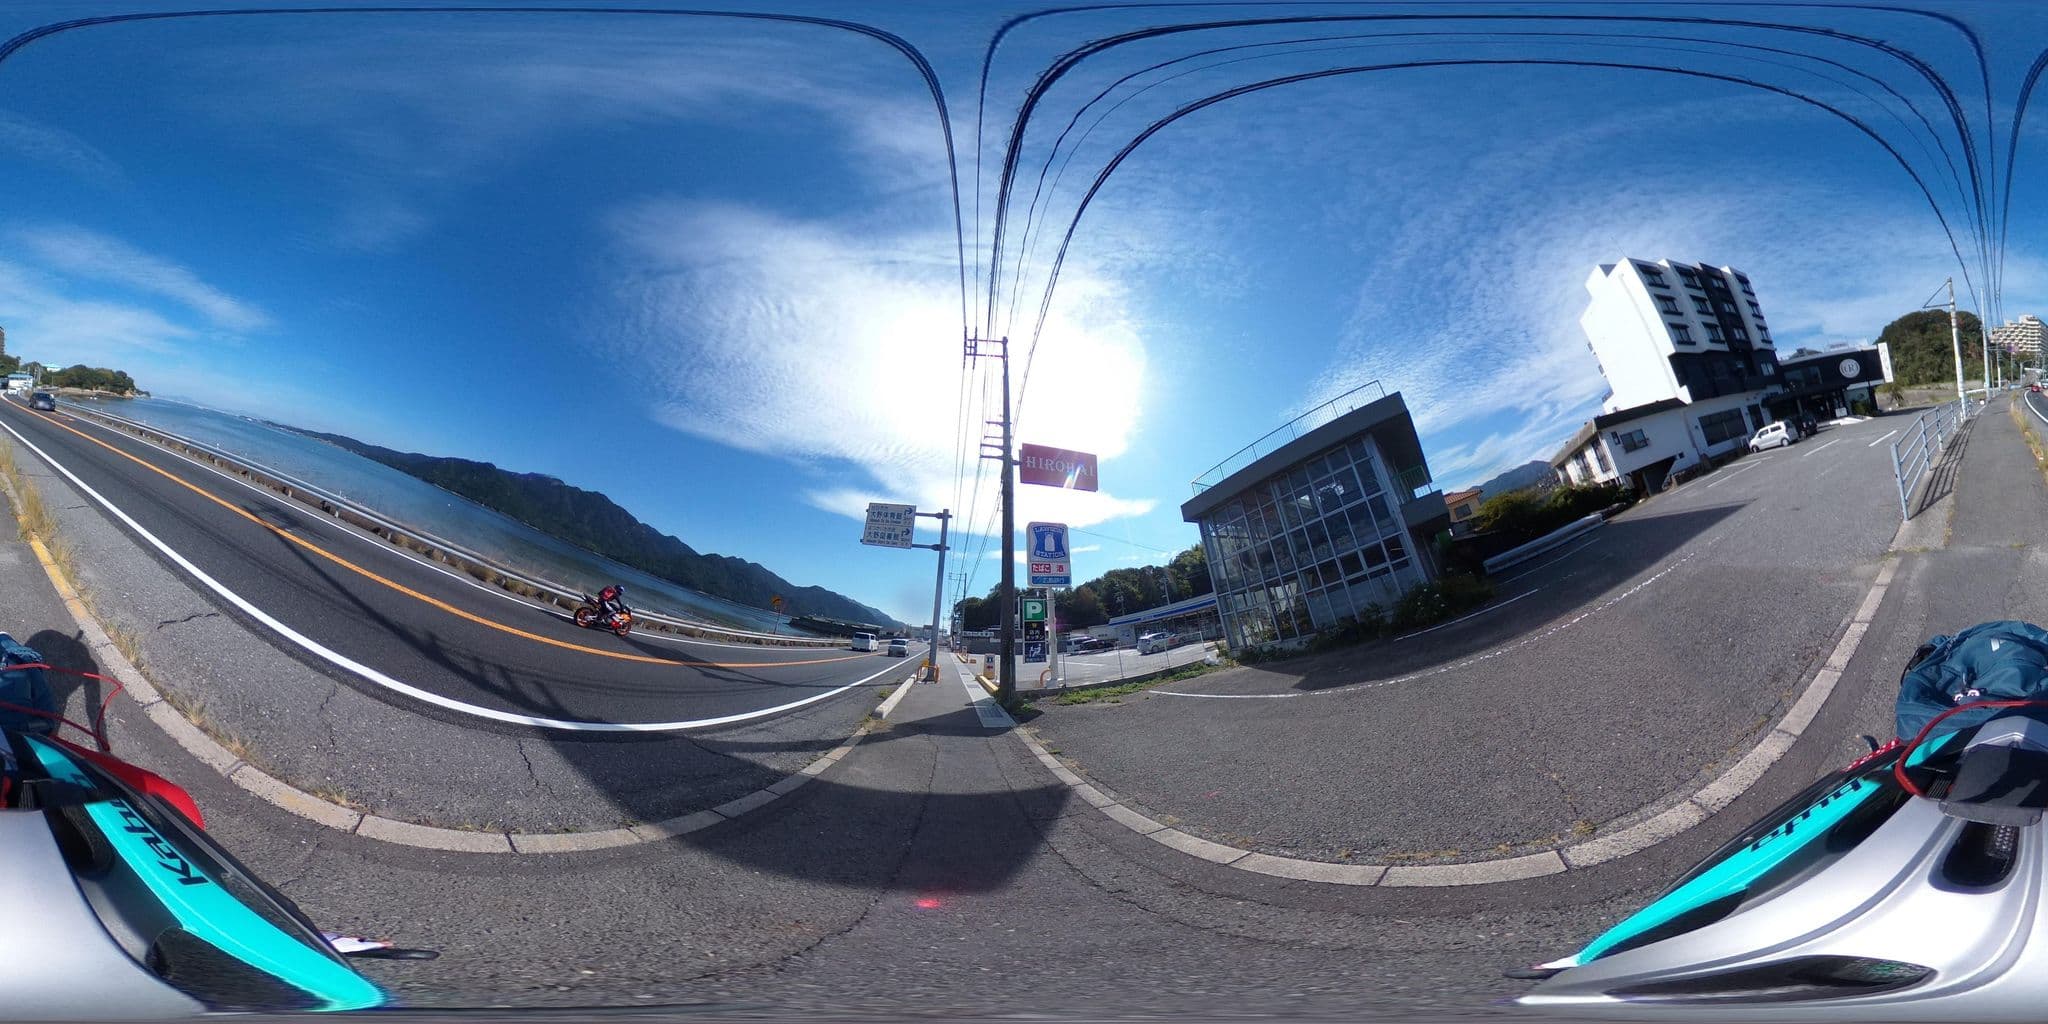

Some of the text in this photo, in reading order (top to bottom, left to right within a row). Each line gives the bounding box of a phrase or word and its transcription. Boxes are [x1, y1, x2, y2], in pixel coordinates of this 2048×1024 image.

[1032, 564, 1051, 573] たばこ
[1026, 601, 1042, 618] P
